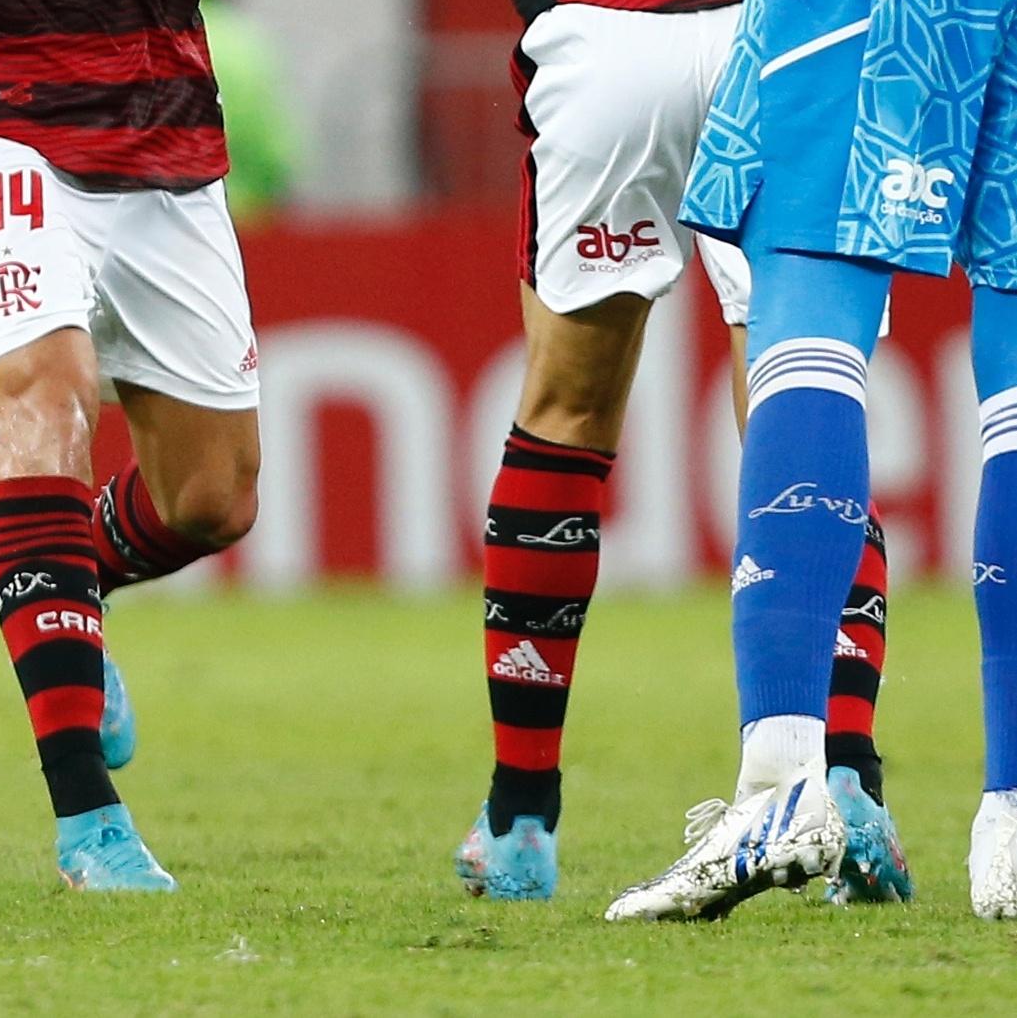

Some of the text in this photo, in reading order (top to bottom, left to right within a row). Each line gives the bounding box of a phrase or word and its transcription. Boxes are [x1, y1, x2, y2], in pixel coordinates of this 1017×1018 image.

[577, 219, 659, 262] abc
[579, 263, 595, 272] da
[517, 517, 600, 545] Luv
